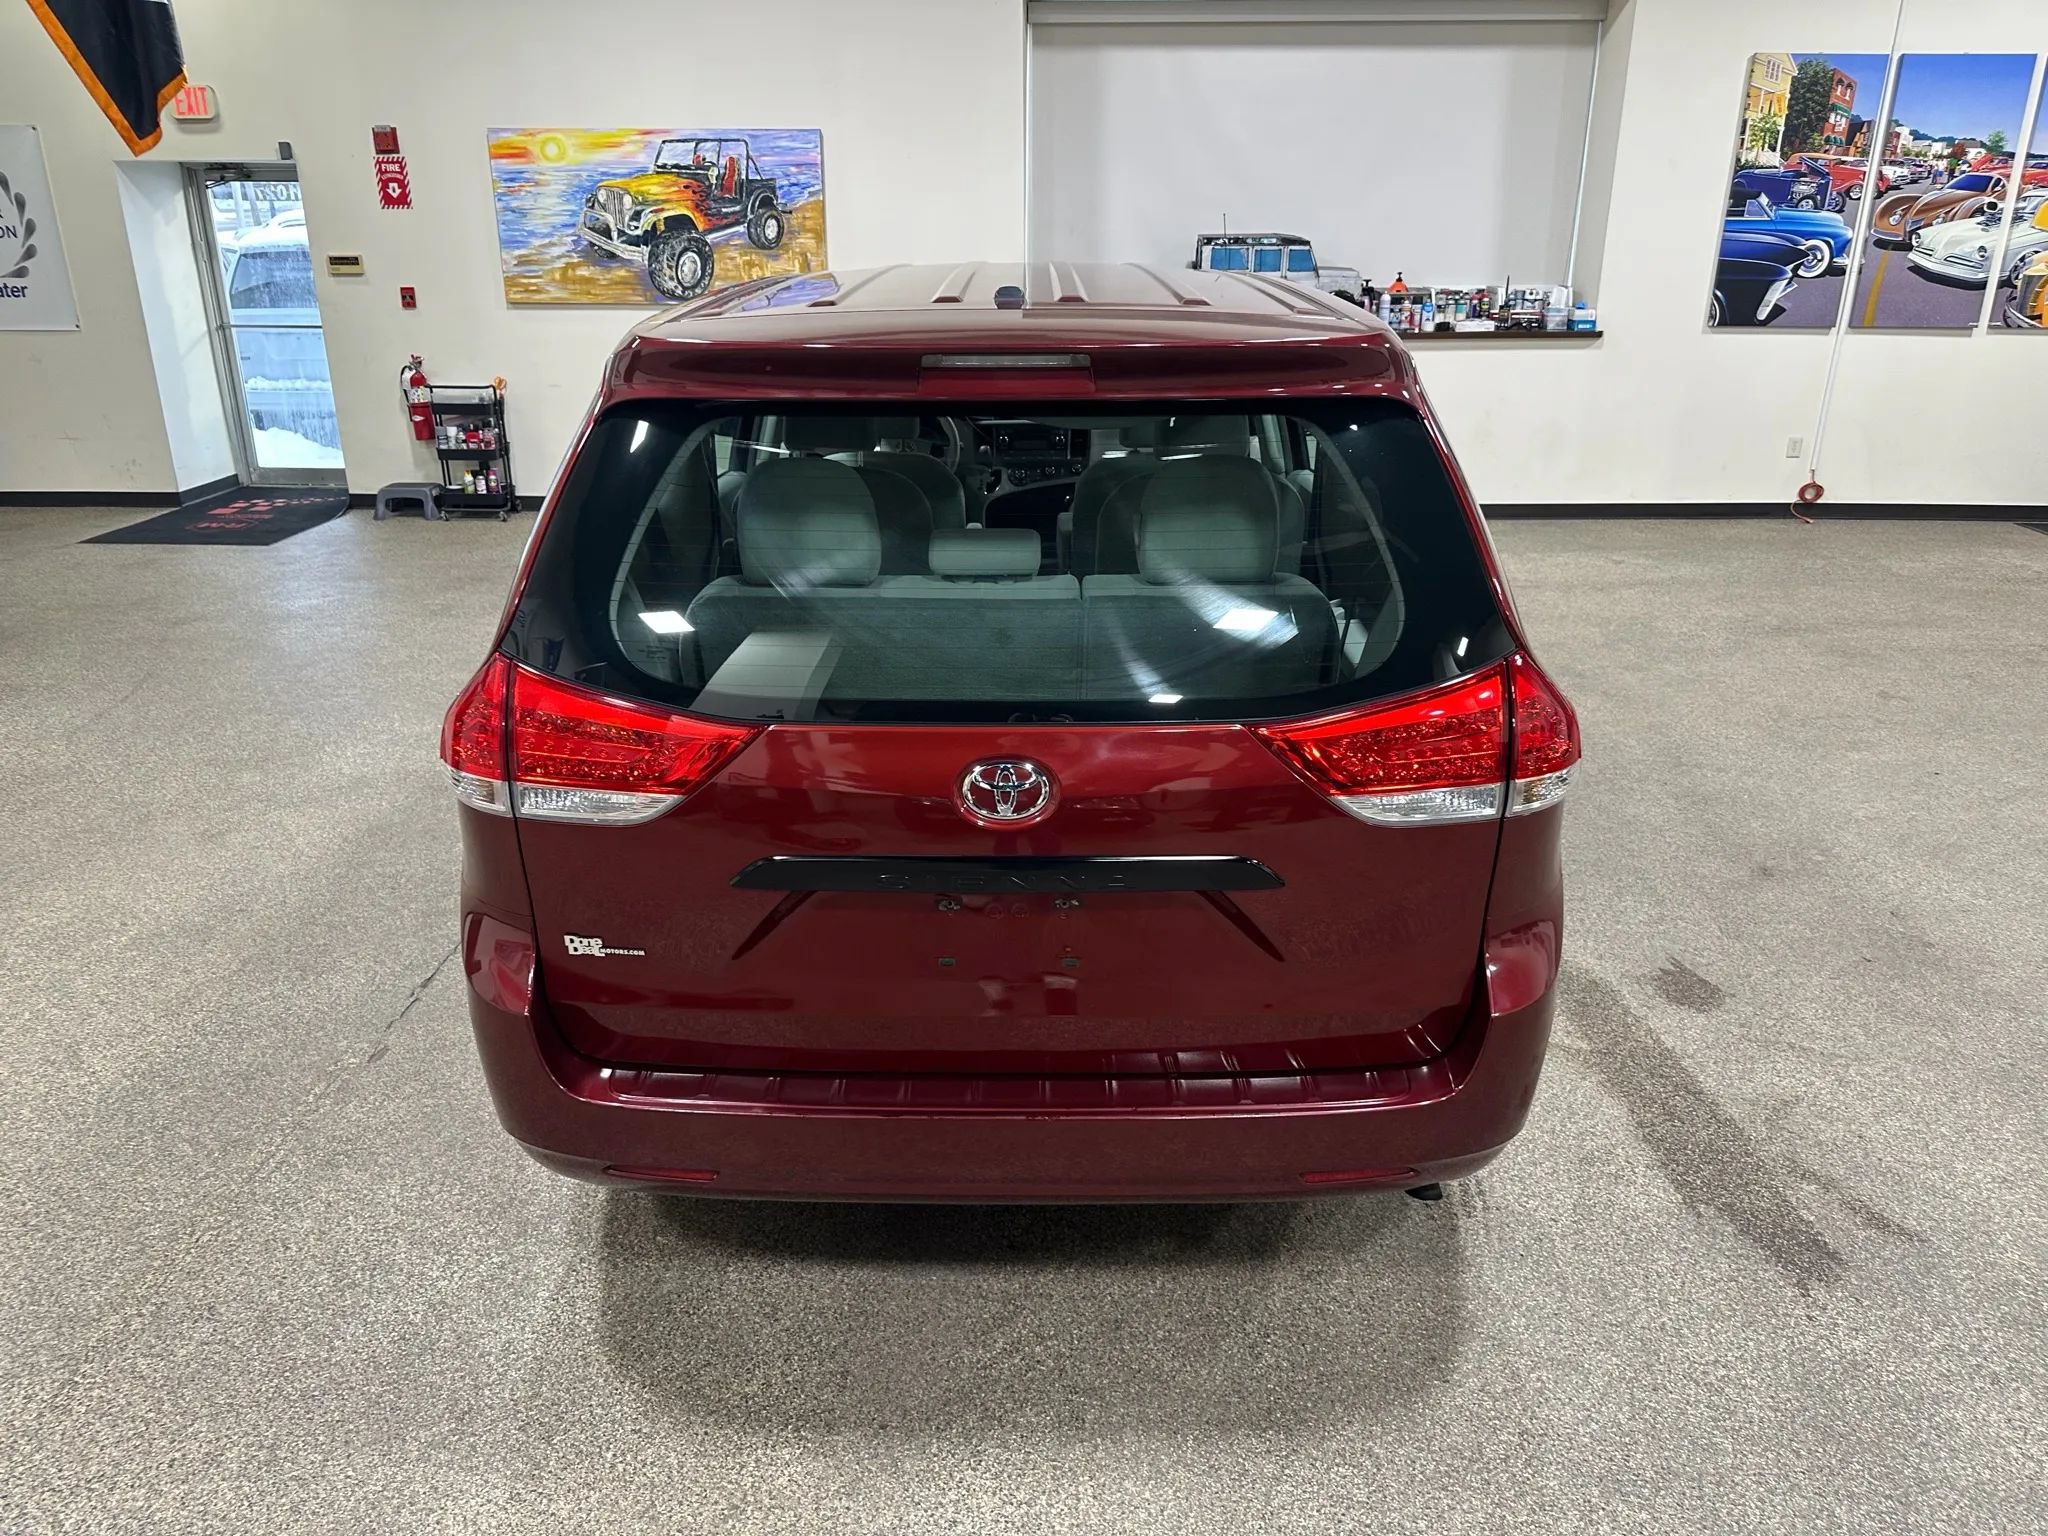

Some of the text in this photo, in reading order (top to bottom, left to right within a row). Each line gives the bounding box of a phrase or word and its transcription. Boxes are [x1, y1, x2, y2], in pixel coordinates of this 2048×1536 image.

[175, 87, 209, 116] EXIT
[381, 164, 401, 172] FIRE
[564, 935, 603, 948] Done
[600, 948, 646, 956] MOTORS.COM
